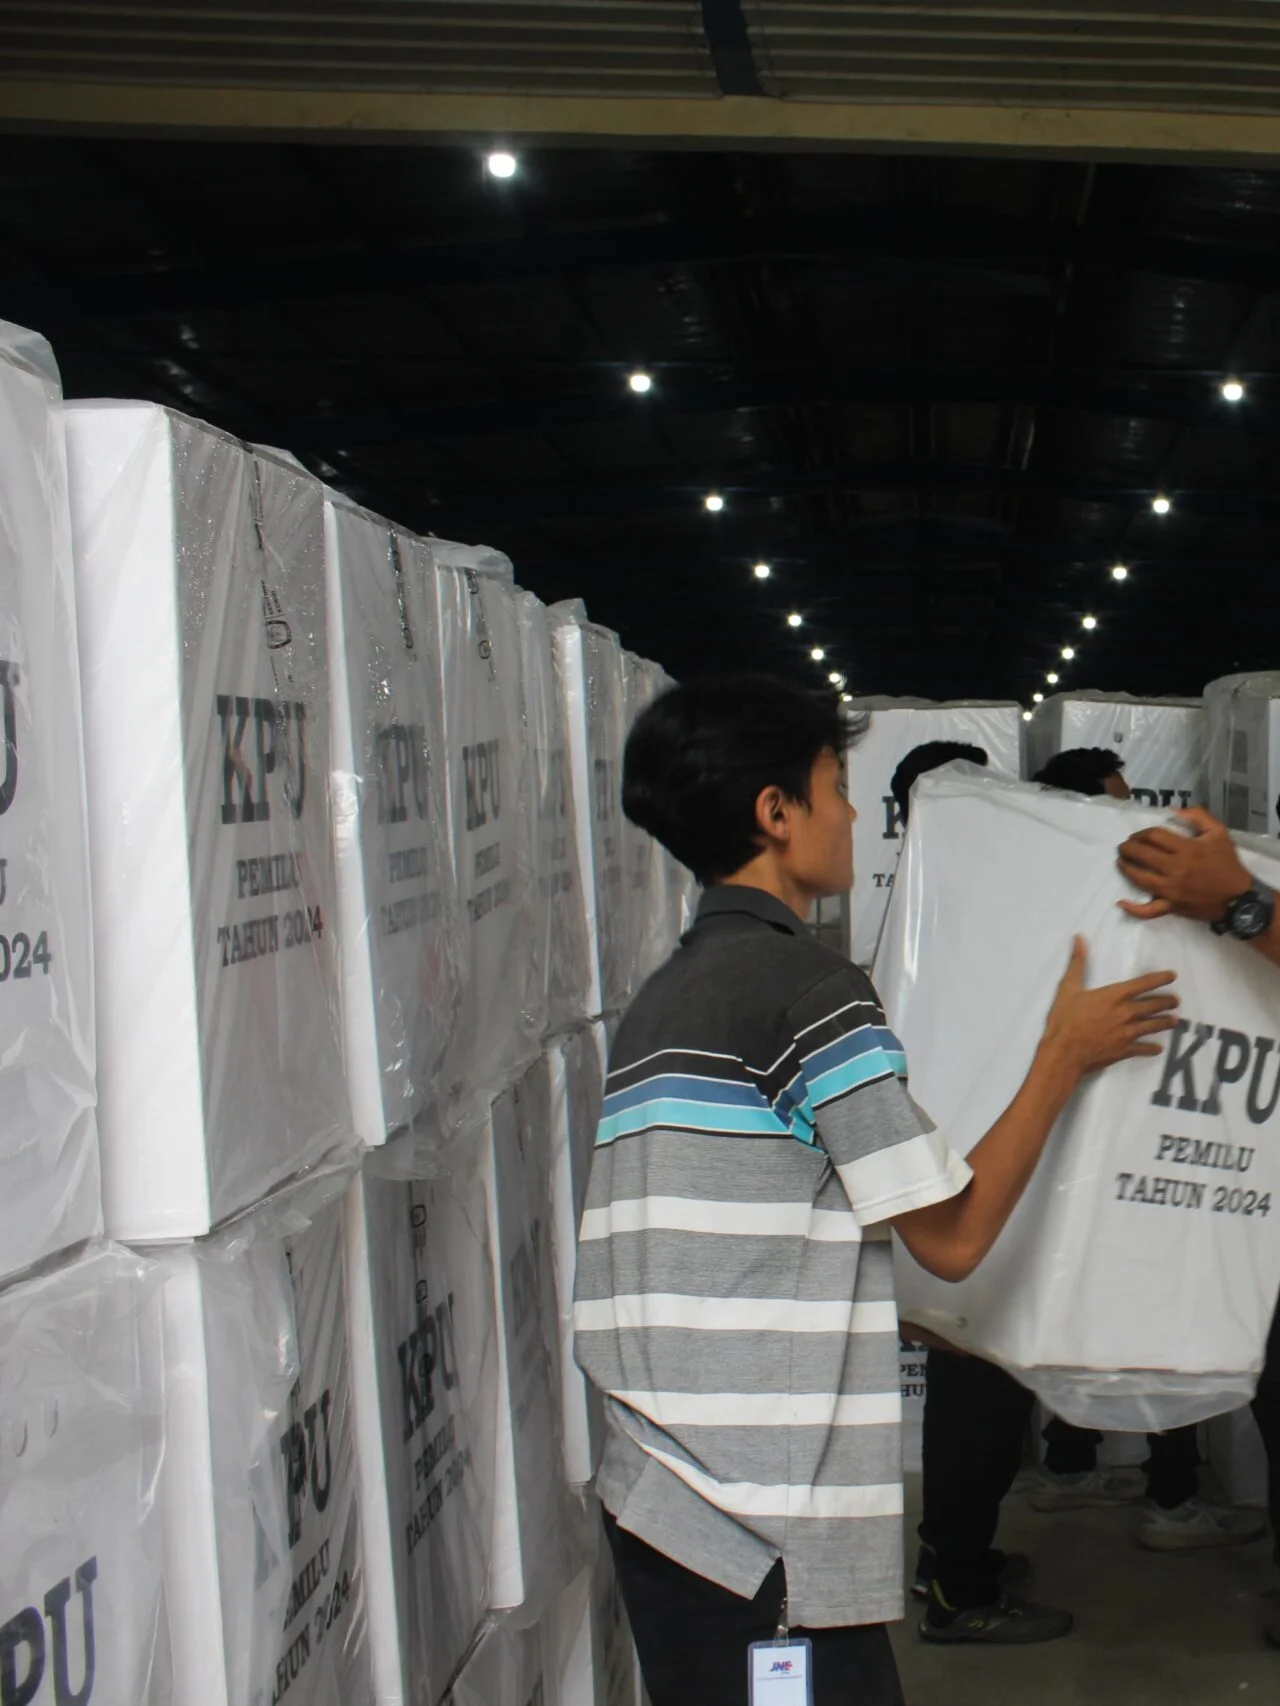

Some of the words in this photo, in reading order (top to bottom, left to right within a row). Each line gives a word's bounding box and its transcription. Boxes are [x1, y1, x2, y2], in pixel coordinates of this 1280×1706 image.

[216, 694, 306, 825] KPU
[217, 914, 279, 968] TAHUN
[1115, 1172, 1207, 1210] TAHUN
[1211, 1185, 1273, 1218] 2024
[1154, 1134, 1256, 1173] PEMILU
[281, 1388, 331, 1551] PU
[0, 1554, 98, 1706] PU
